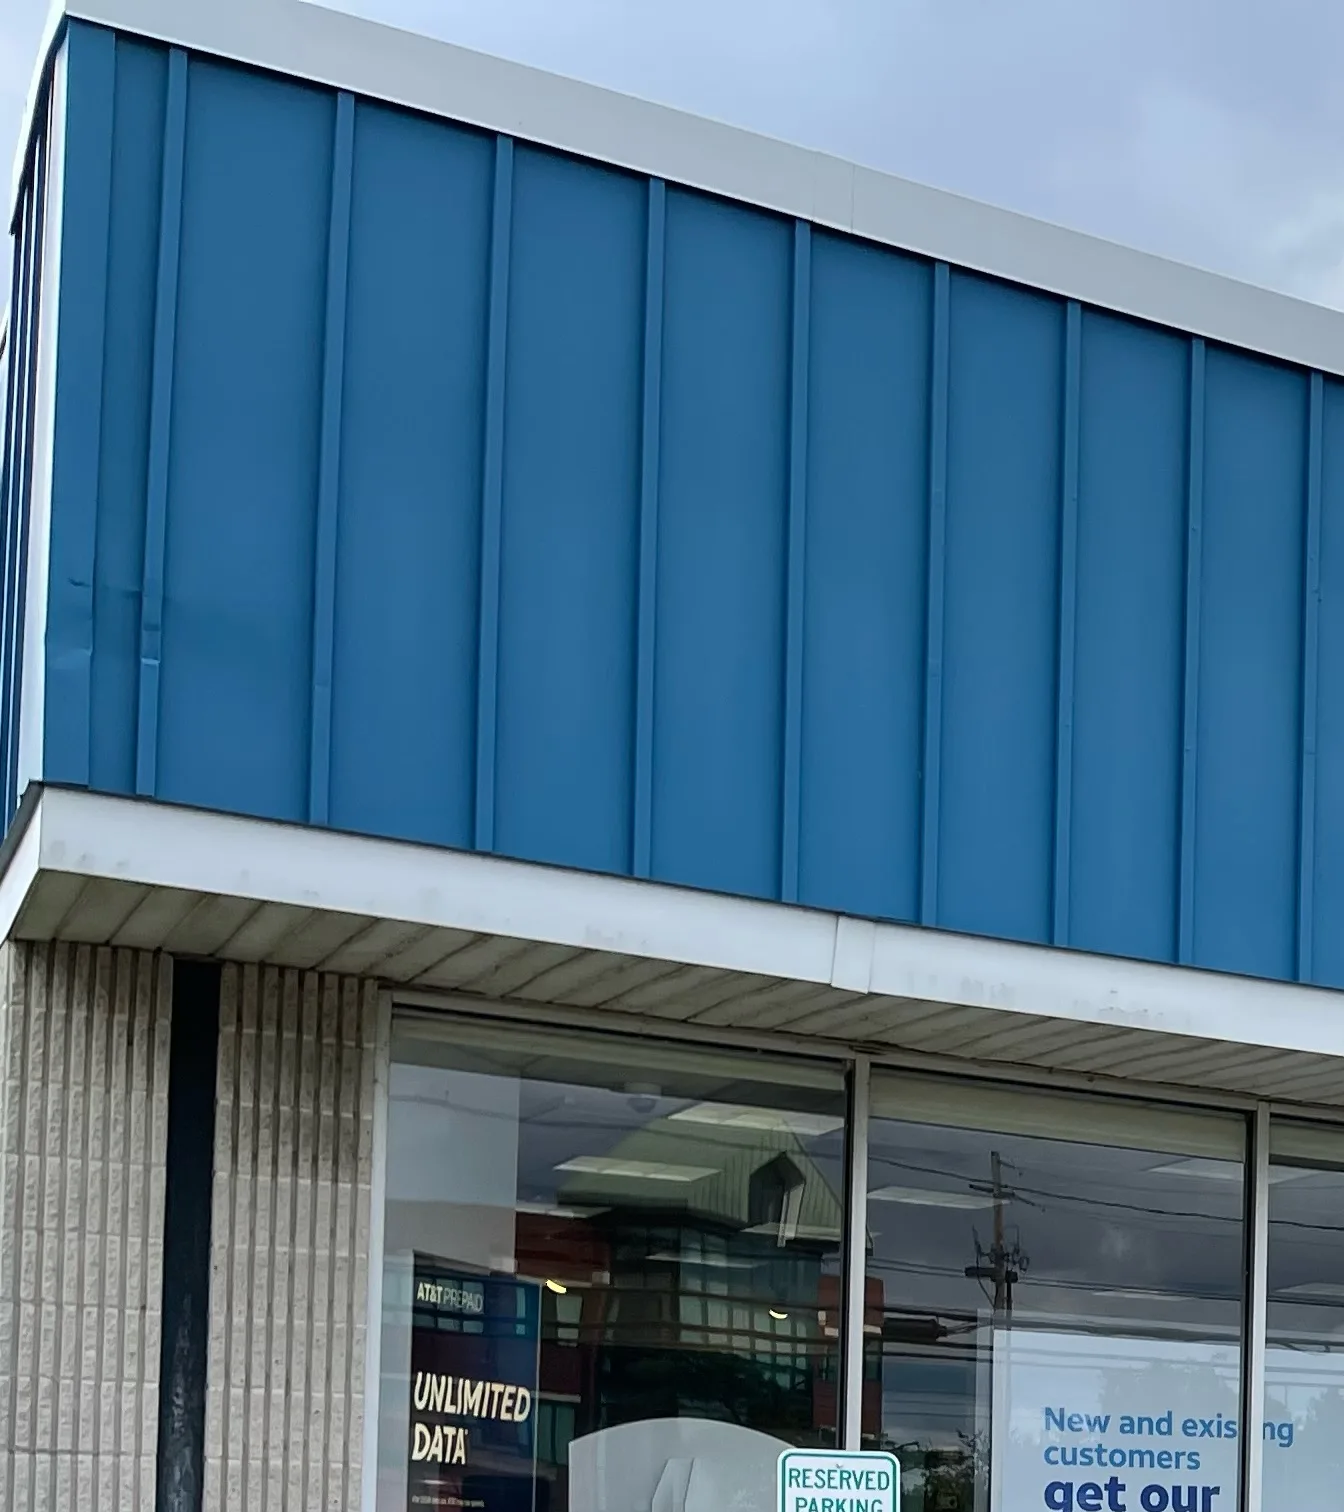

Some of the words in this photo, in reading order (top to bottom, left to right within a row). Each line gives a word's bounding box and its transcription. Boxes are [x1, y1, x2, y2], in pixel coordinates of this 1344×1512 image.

[417, 1282, 443, 1303] AT&T
[414, 1371, 531, 1422] UNLIMITED
[1044, 1407, 1111, 1433] New
[1119, 1411, 1172, 1436] and
[1182, 1413, 1294, 1448] exisng
[1044, 1443, 1200, 1470] customers
[788, 1468, 890, 1491] RESERVED
